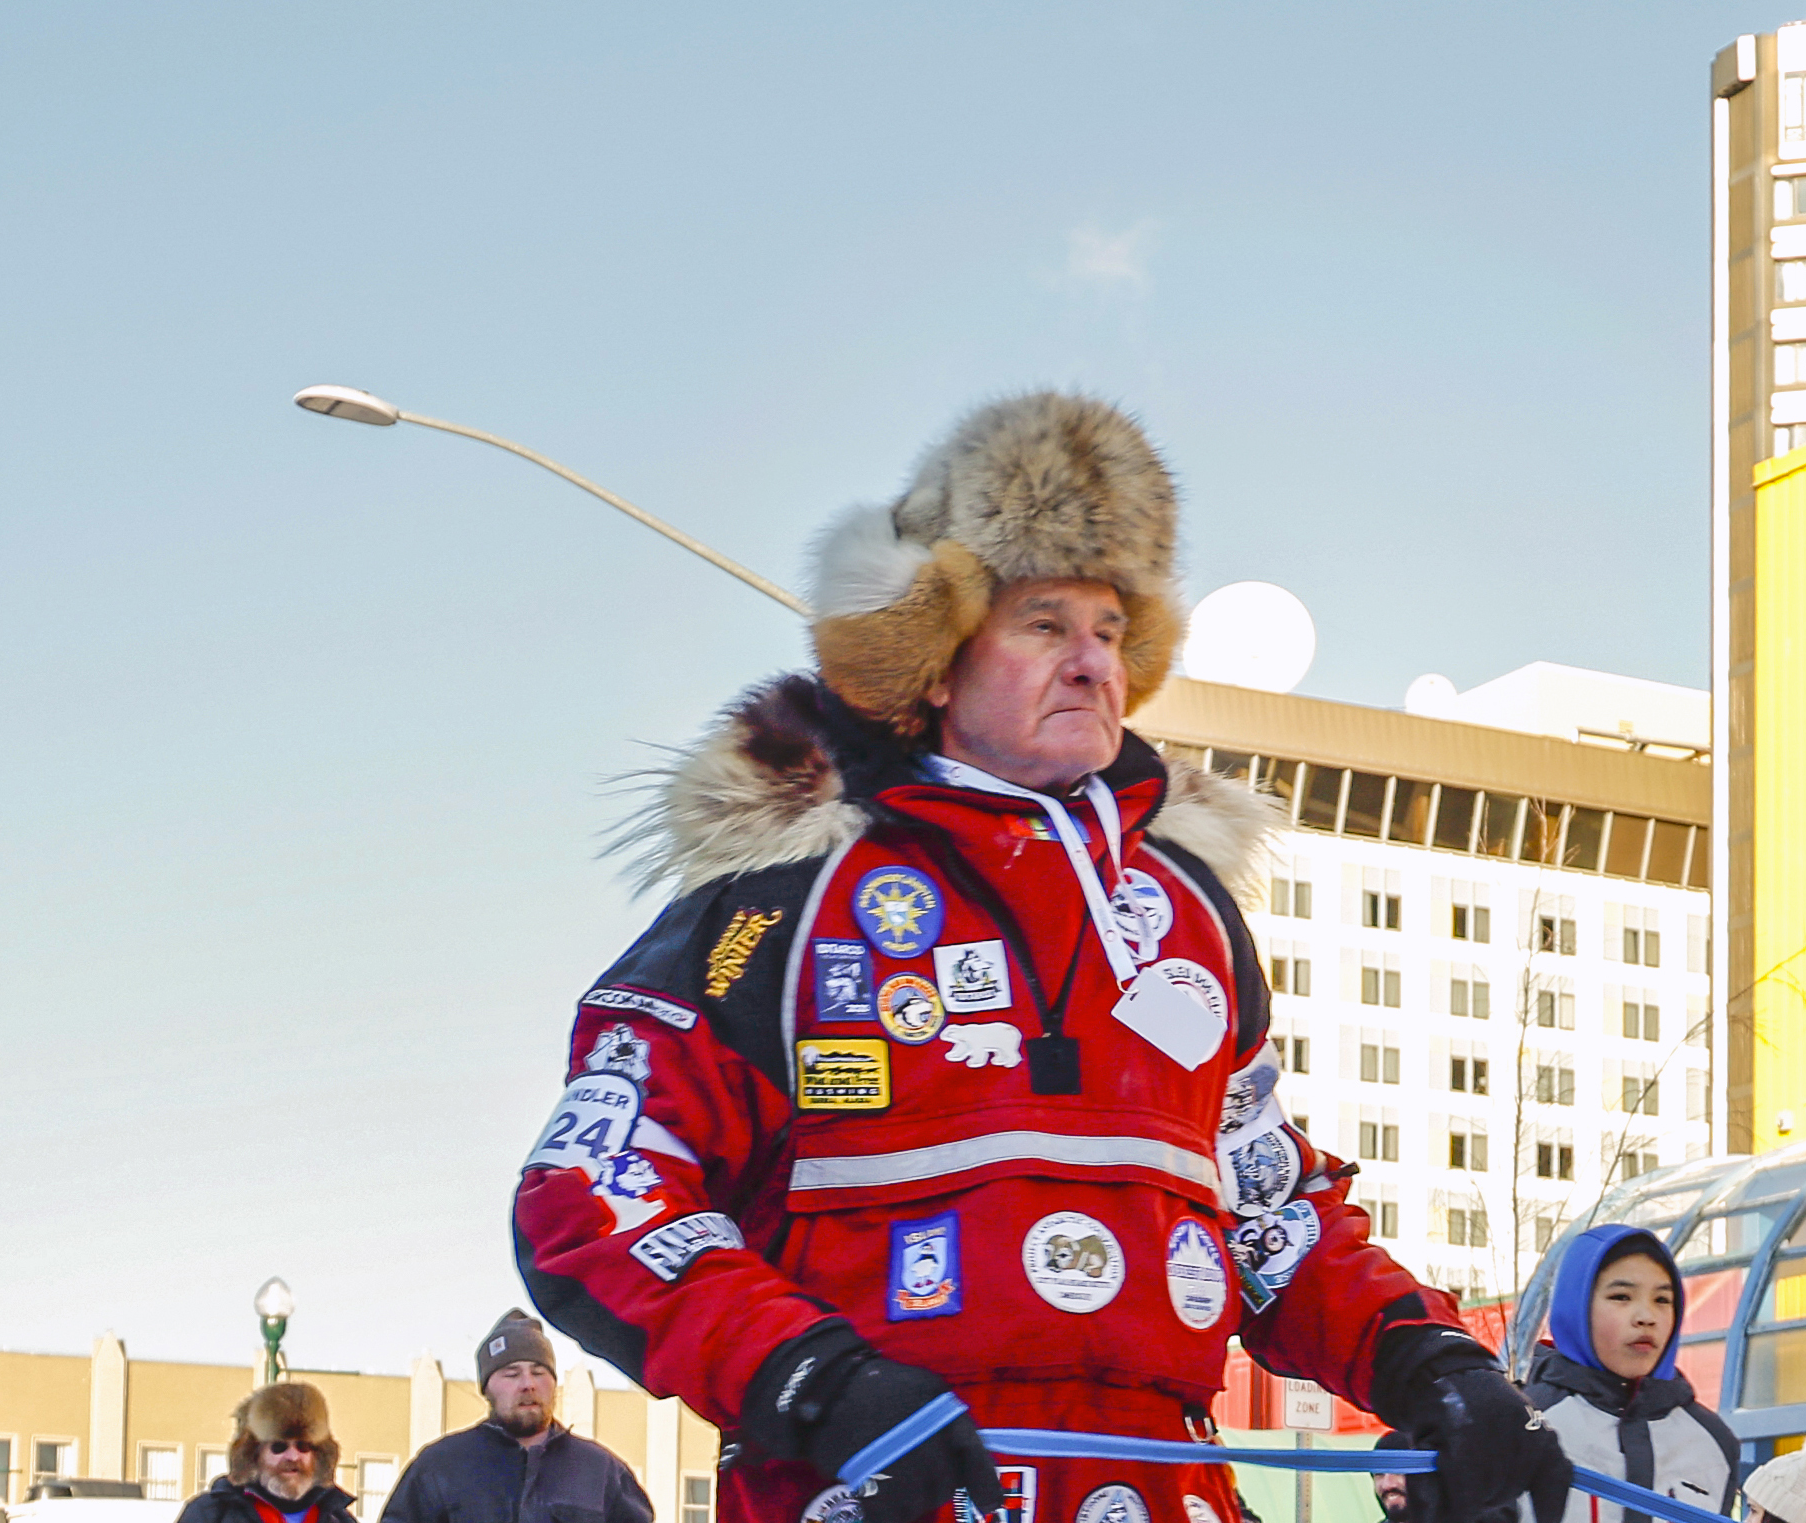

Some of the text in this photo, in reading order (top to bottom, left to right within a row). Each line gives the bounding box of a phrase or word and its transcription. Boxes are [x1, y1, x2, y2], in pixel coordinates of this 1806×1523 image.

[540, 1111, 614, 1160] 24
[1288, 1380, 1327, 1394] LOADIN
[1296, 1400, 1320, 1414] ZONE
